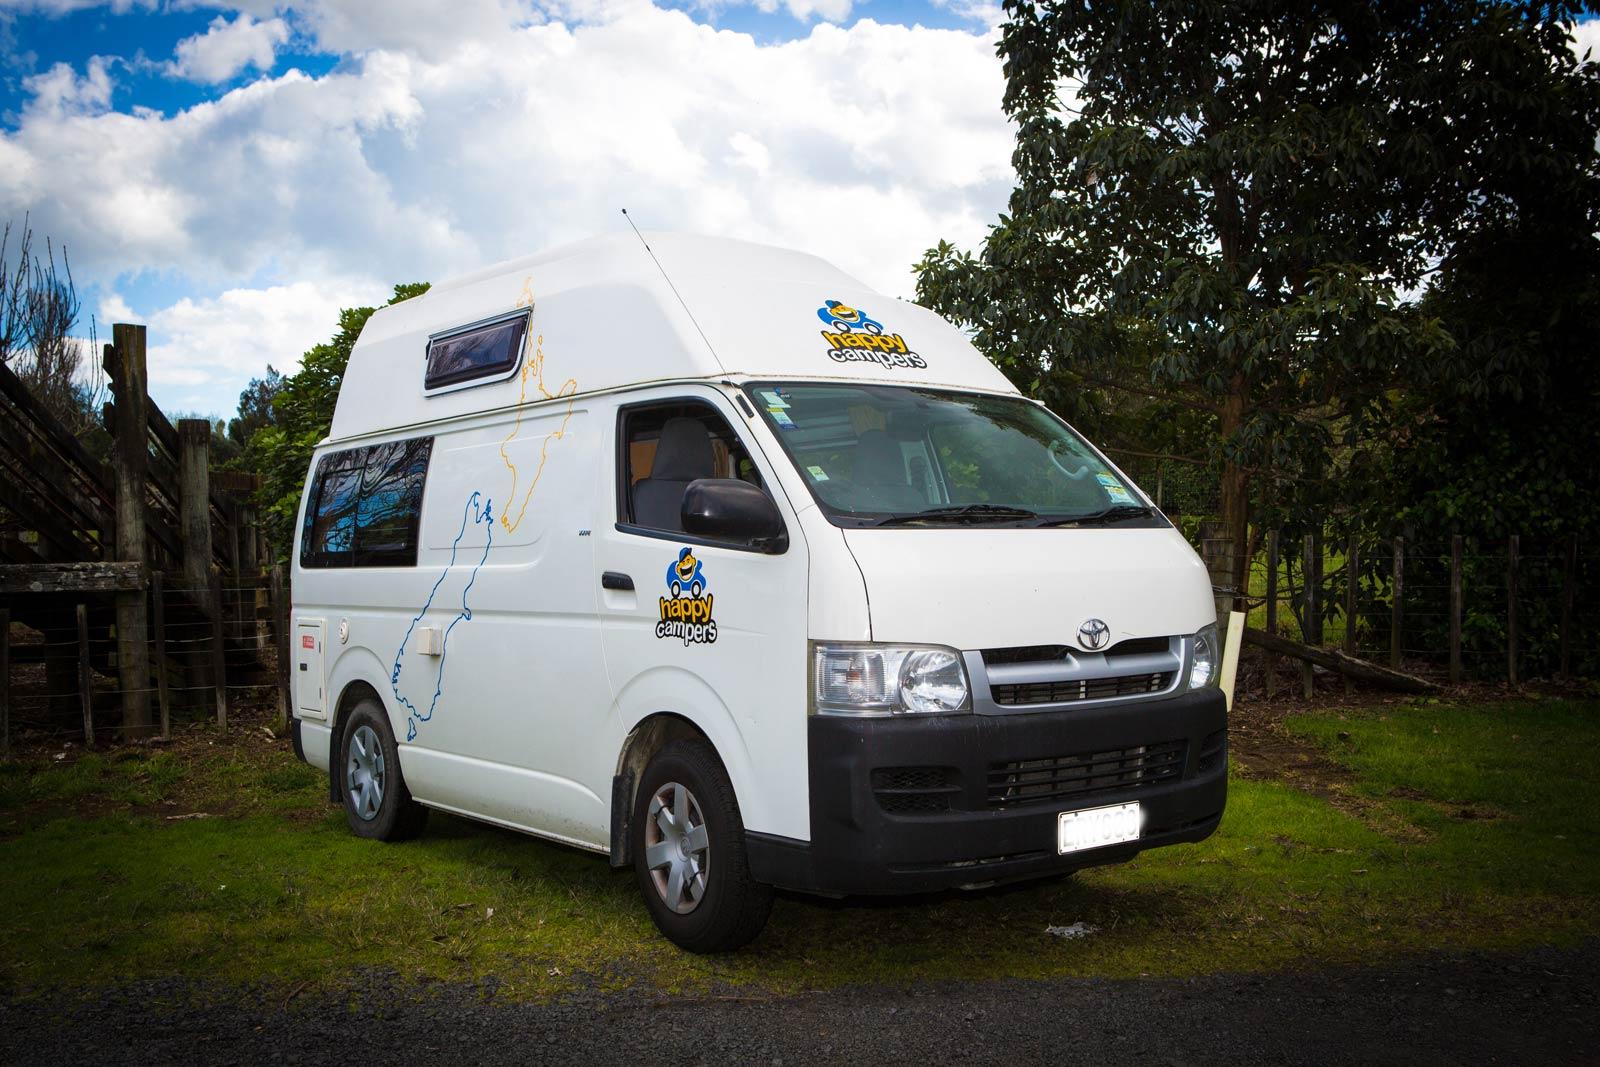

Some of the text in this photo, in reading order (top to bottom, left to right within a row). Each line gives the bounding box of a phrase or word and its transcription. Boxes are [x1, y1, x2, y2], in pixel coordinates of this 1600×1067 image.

[821, 330, 908, 353] happy
[828, 348, 927, 369] campers
[659, 593, 714, 623] happy
[655, 620, 718, 647] campers
